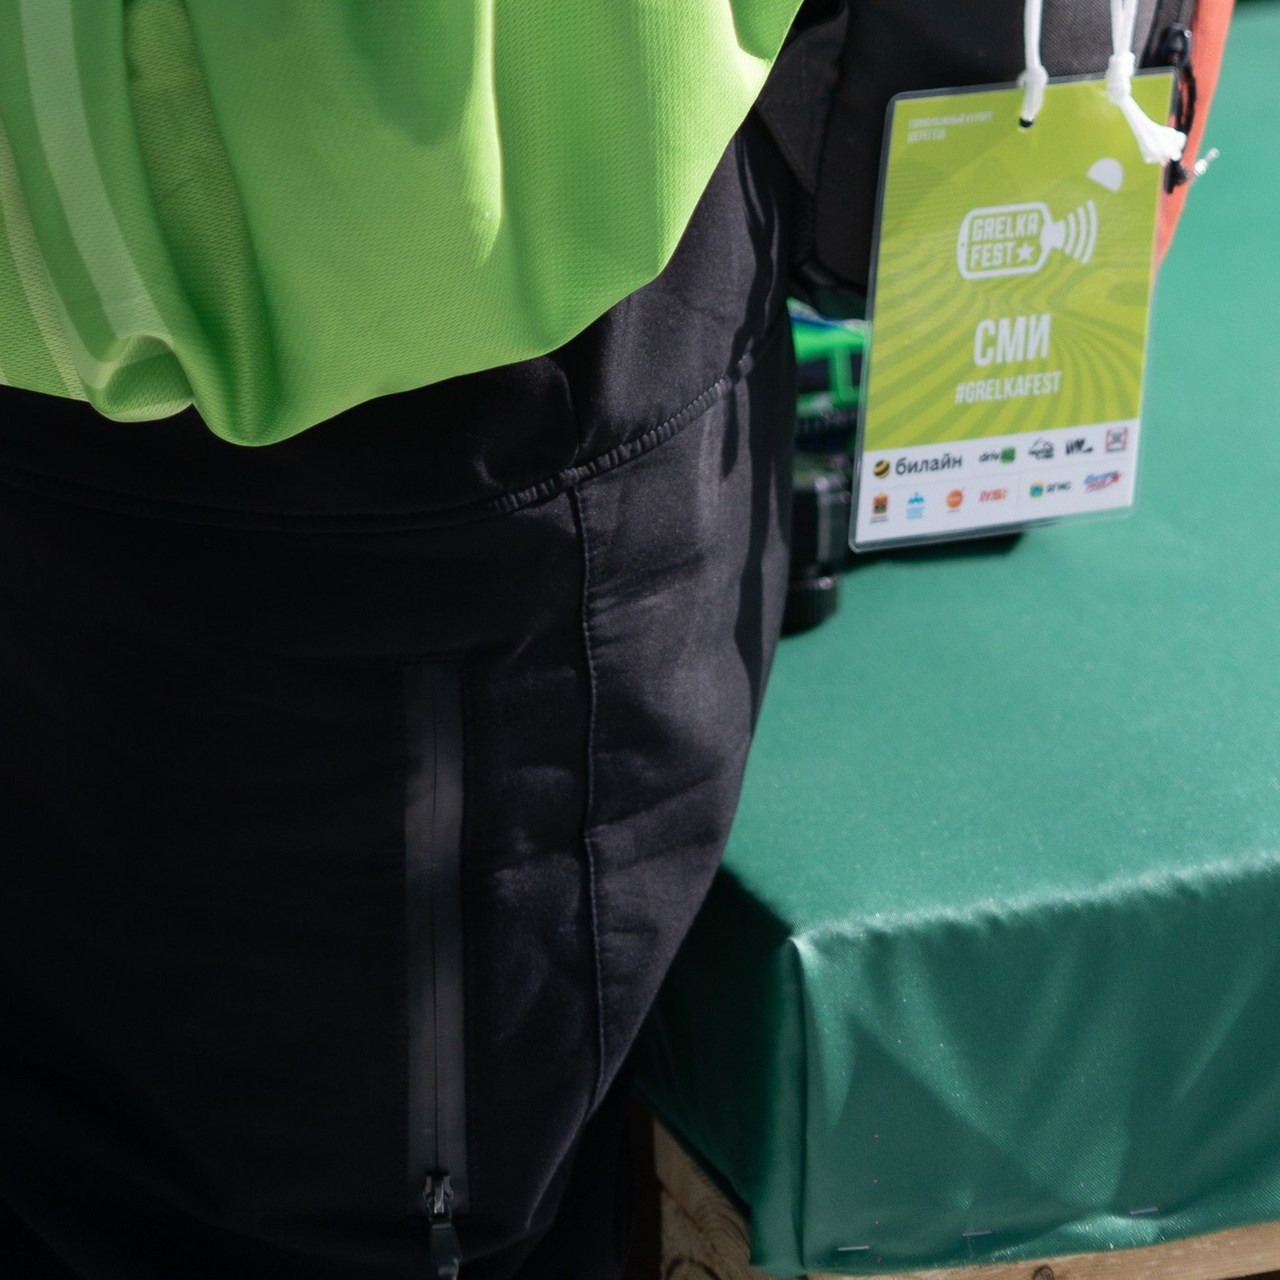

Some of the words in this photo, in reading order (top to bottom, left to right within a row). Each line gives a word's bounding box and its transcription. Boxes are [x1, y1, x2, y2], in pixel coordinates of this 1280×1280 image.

[972, 212, 1039, 242] GRELKA
[970, 241, 1016, 269] FEST
[973, 312, 1052, 367] СМИ
[955, 371, 1062, 405] #GRELKAFEST
[895, 453, 963, 476] билайн
